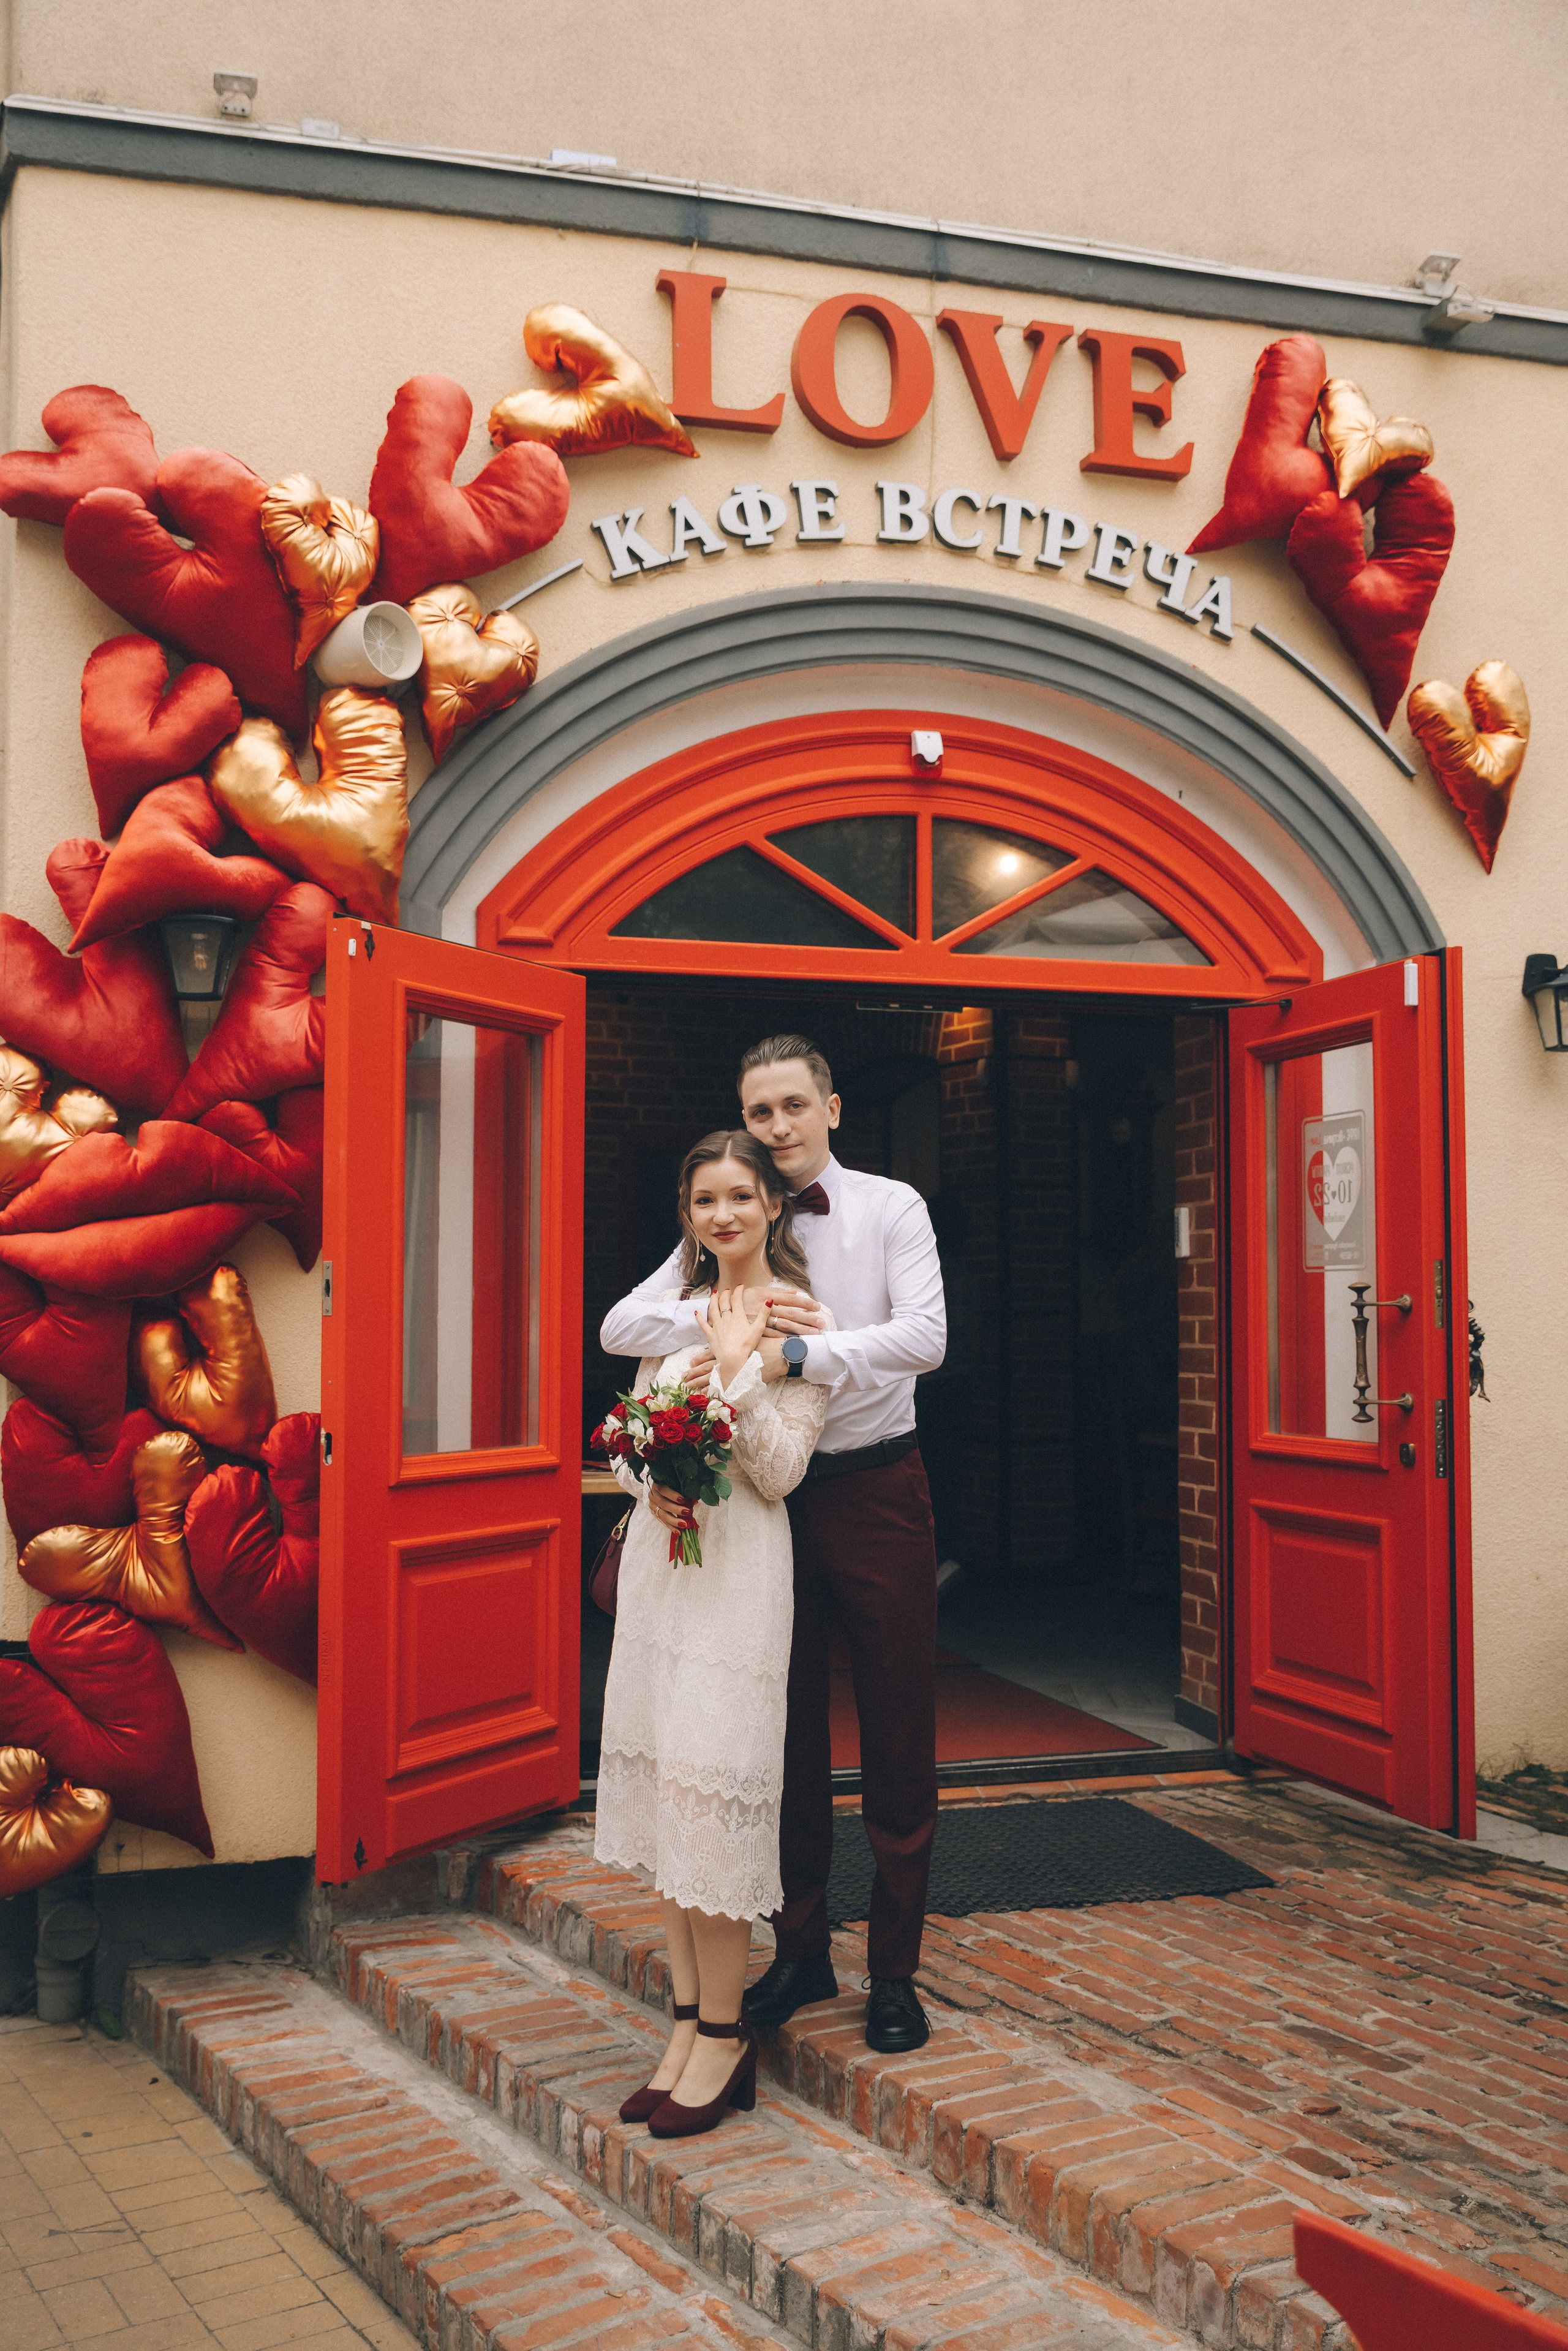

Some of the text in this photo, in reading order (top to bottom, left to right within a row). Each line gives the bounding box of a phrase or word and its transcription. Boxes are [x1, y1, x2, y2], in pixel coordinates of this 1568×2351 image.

[655, 269, 1194, 481] LOVE
[590, 480, 1233, 642] КАФЕ ВСТРЕЧА
